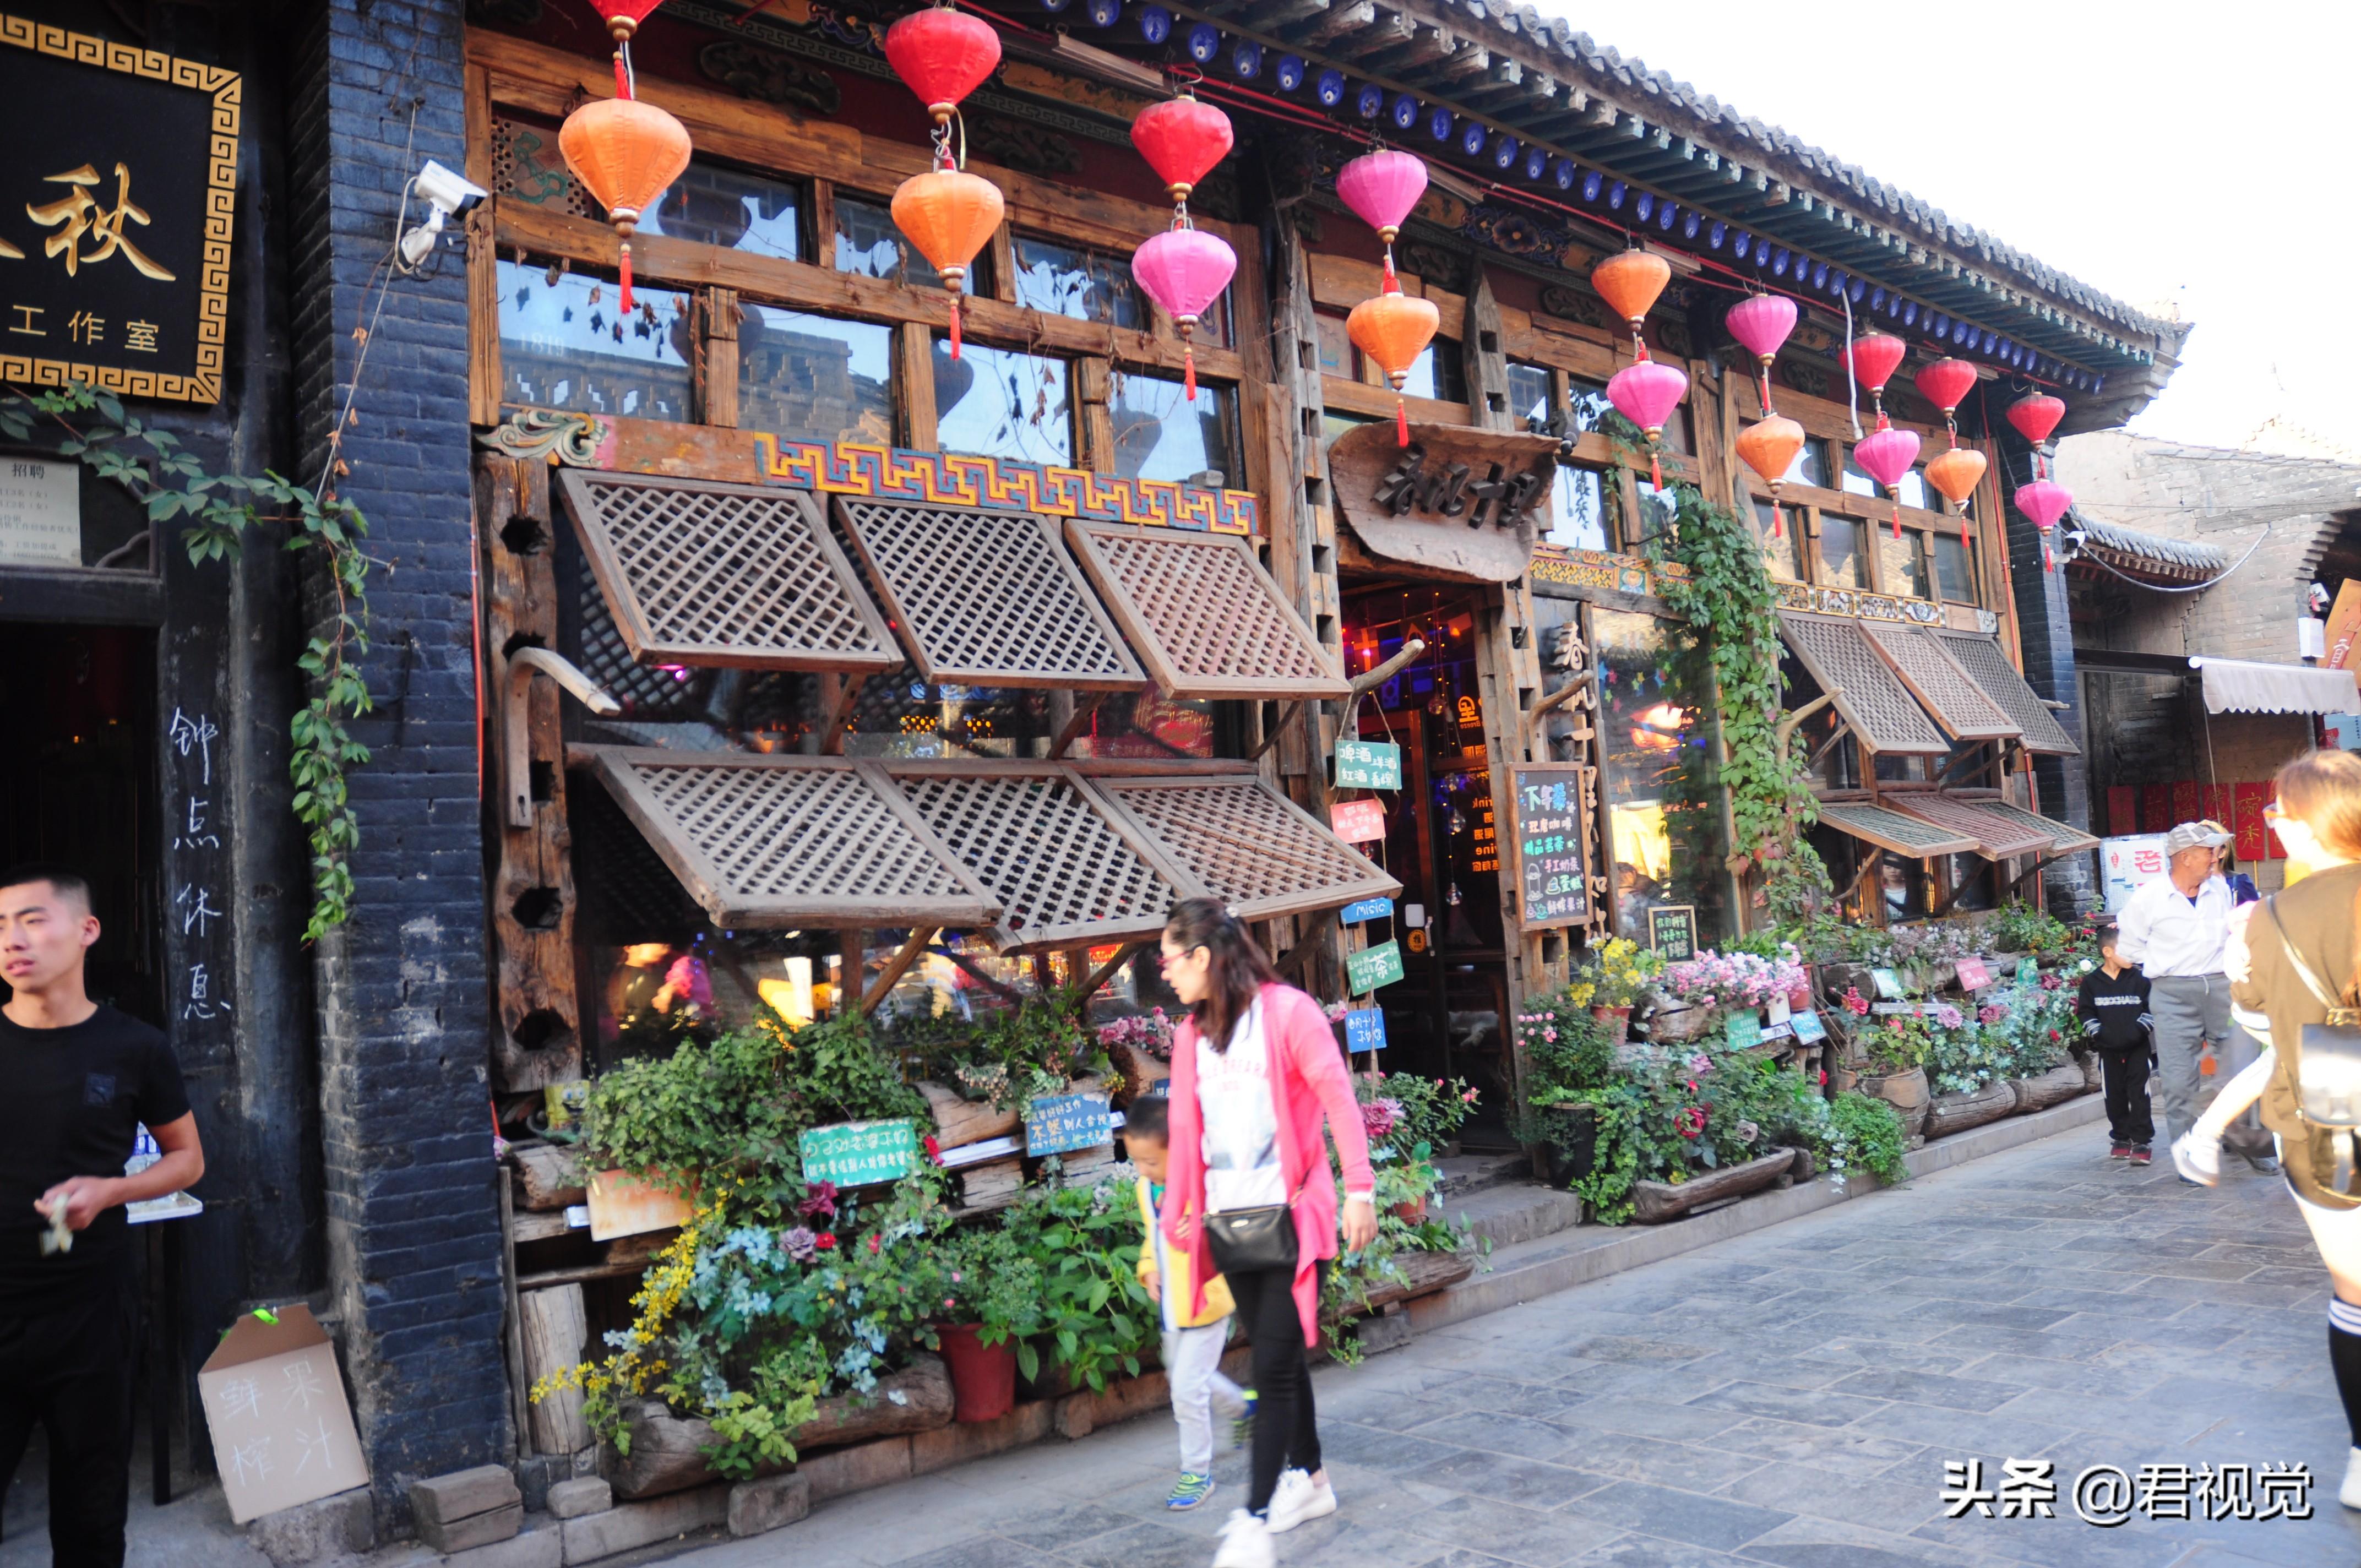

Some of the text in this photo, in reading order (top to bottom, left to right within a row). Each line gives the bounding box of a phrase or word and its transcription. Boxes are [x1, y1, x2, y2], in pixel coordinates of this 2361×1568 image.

[0, 162, 176, 281] 秋
[9, 304, 159, 353] 工作室
[12, 462, 45, 479] 招聘
[1374, 442, 1539, 530] 春风十里
[1339, 744, 1397, 770] 啤酒 洋酒
[1342, 767, 1368, 782] 红酒
[1524, 782, 1566, 812] 下午茶
[1528, 816, 1573, 834] 现磨咖啡
[2237, 792, 2262, 850] 碗秃
[170, 706, 231, 1021] 钟点休息
[1544, 857, 1580, 874] 手工奶茶
[1559, 874, 1584, 893] 蛋糕
[1547, 896, 1586, 915] 鲜榨果汁
